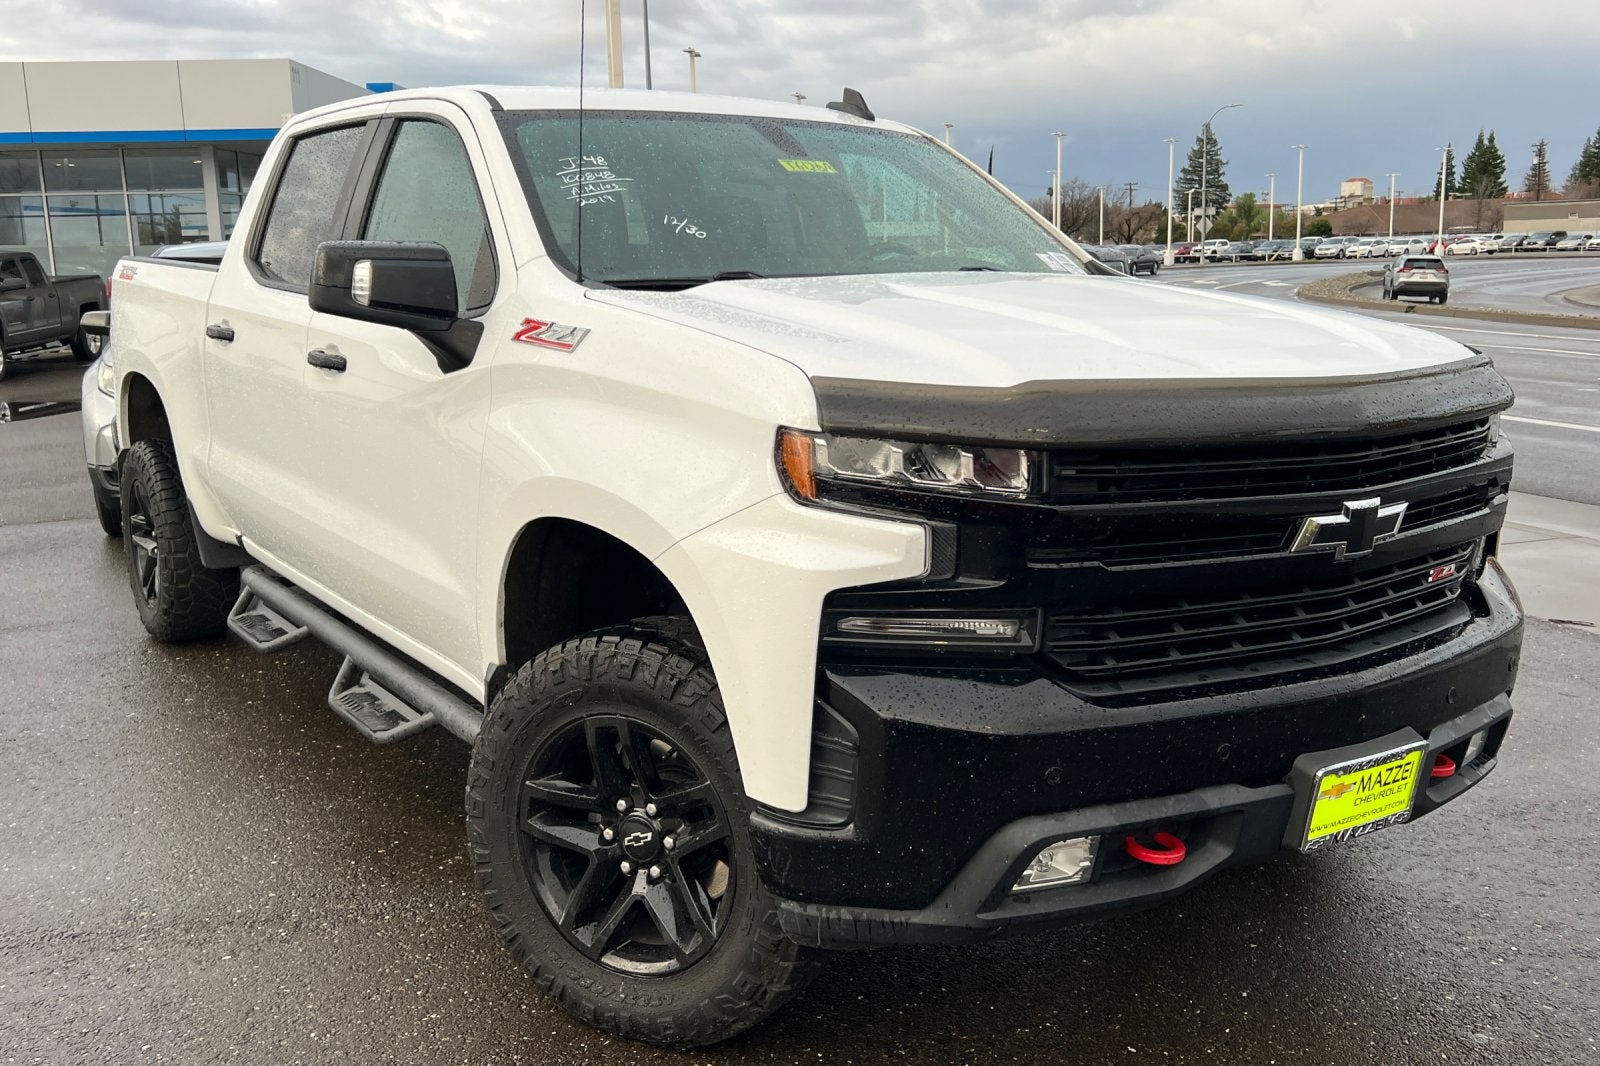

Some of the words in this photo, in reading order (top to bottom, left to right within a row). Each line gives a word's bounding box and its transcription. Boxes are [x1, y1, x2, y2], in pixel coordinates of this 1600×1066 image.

[663, 214, 707, 239] 12/30
[1356, 761, 1415, 795] MAZZEI
[1353, 782, 1409, 807] CHEVROLET
